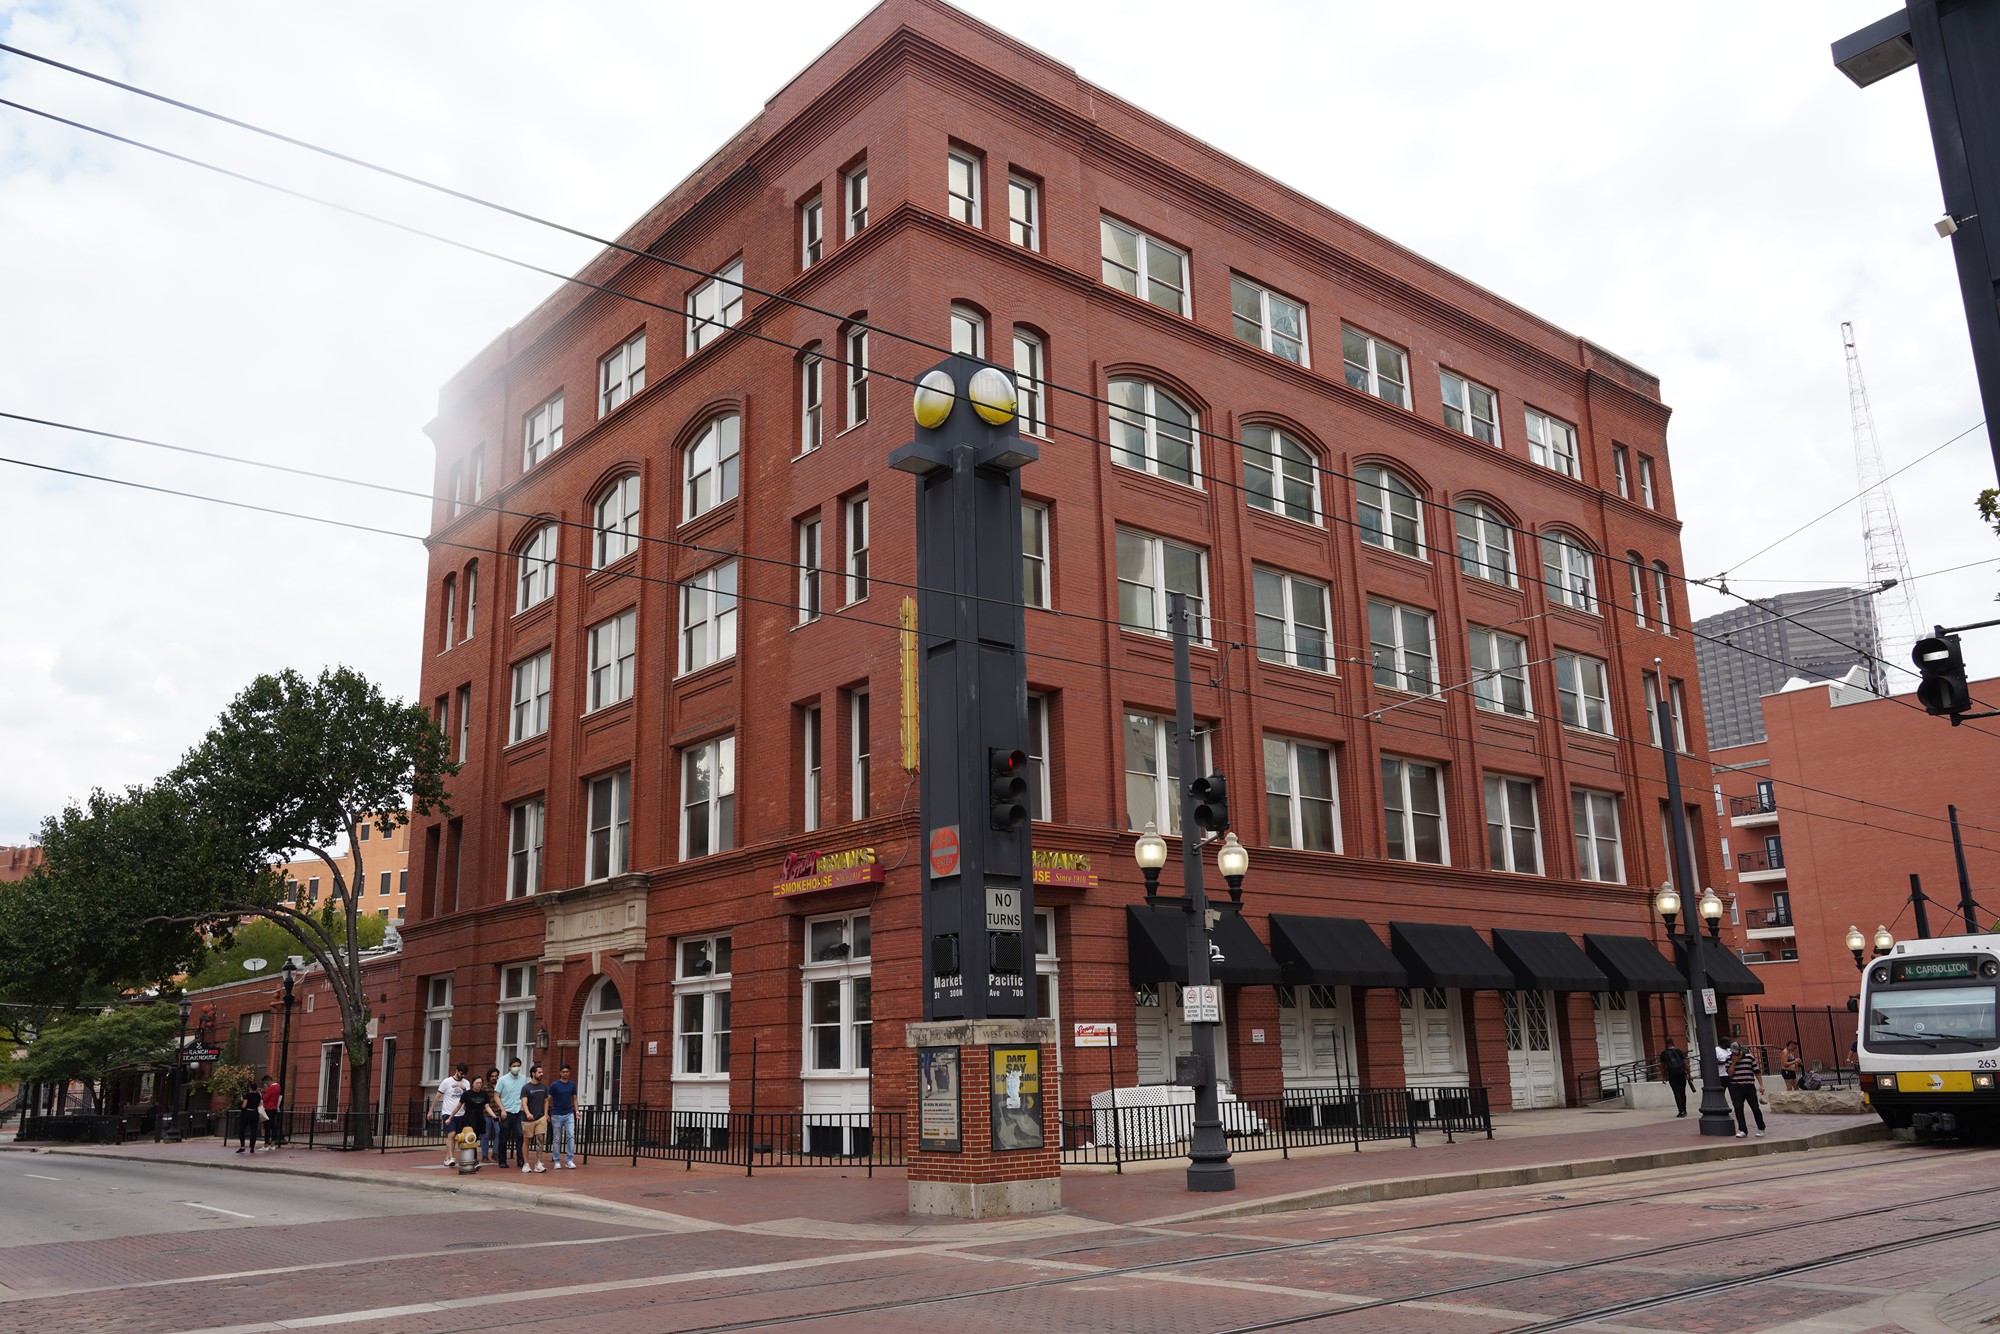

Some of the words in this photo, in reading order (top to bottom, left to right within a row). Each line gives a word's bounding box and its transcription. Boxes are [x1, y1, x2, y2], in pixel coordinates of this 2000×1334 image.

[780, 851, 821, 881] Sonny
[816, 847, 876, 875] BRYAN'S
[1033, 850, 1092, 871] RYAN'S
[1033, 871, 1051, 883] USE
[1055, 872, 1072, 883] Since
[1073, 875, 1087, 884] 1910
[780, 874, 833, 895] SMOKEHOUSE
[995, 893, 1012, 907] NO
[987, 913, 1020, 926] TURNS
[1905, 966, 1914, 975] N.
[1916, 963, 1968, 975] CARROLLTON
[934, 974, 962, 988] Market
[988, 974, 1024, 986] Pacific
[934, 991, 940, 999] St
[989, 989, 1000, 997] Ave
[1012, 989, 1024, 997] 700
[982, 1031, 1001, 1039] WEST
[1021, 1030, 1048, 1038] STATION
[1006, 1054, 1026, 1062] DART
[1977, 1060, 1997, 1068] 263
[1006, 1064, 1026, 1074] SAY
